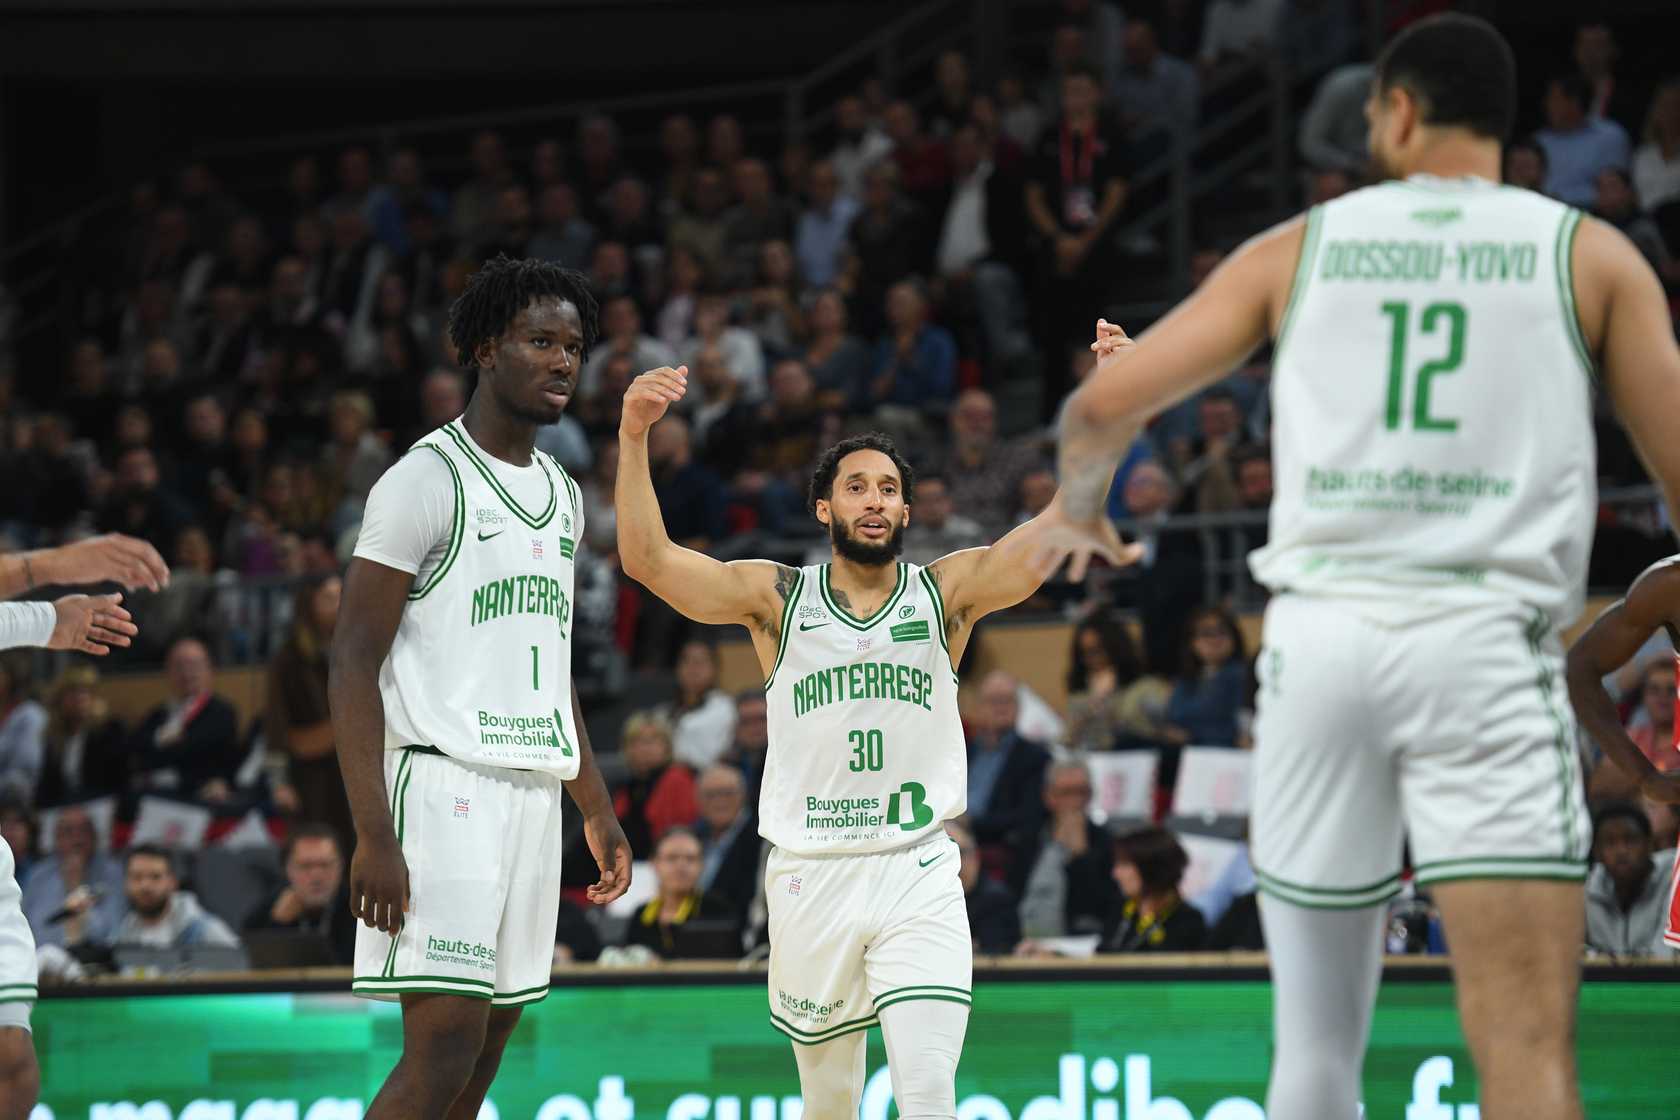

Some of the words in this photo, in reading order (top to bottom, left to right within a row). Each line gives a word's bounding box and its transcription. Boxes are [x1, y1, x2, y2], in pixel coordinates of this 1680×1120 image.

[1321, 241, 1537, 283] DOSSOU-YOVO
[1380, 301, 1468, 432] 12
[531, 646, 539, 690] 1
[793, 662, 932, 718] NANTERRE92
[478, 711, 553, 732] Bouygues
[848, 729, 883, 772] 30
[806, 796, 880, 814] Bouygues
[806, 812, 884, 829] Immobilier
